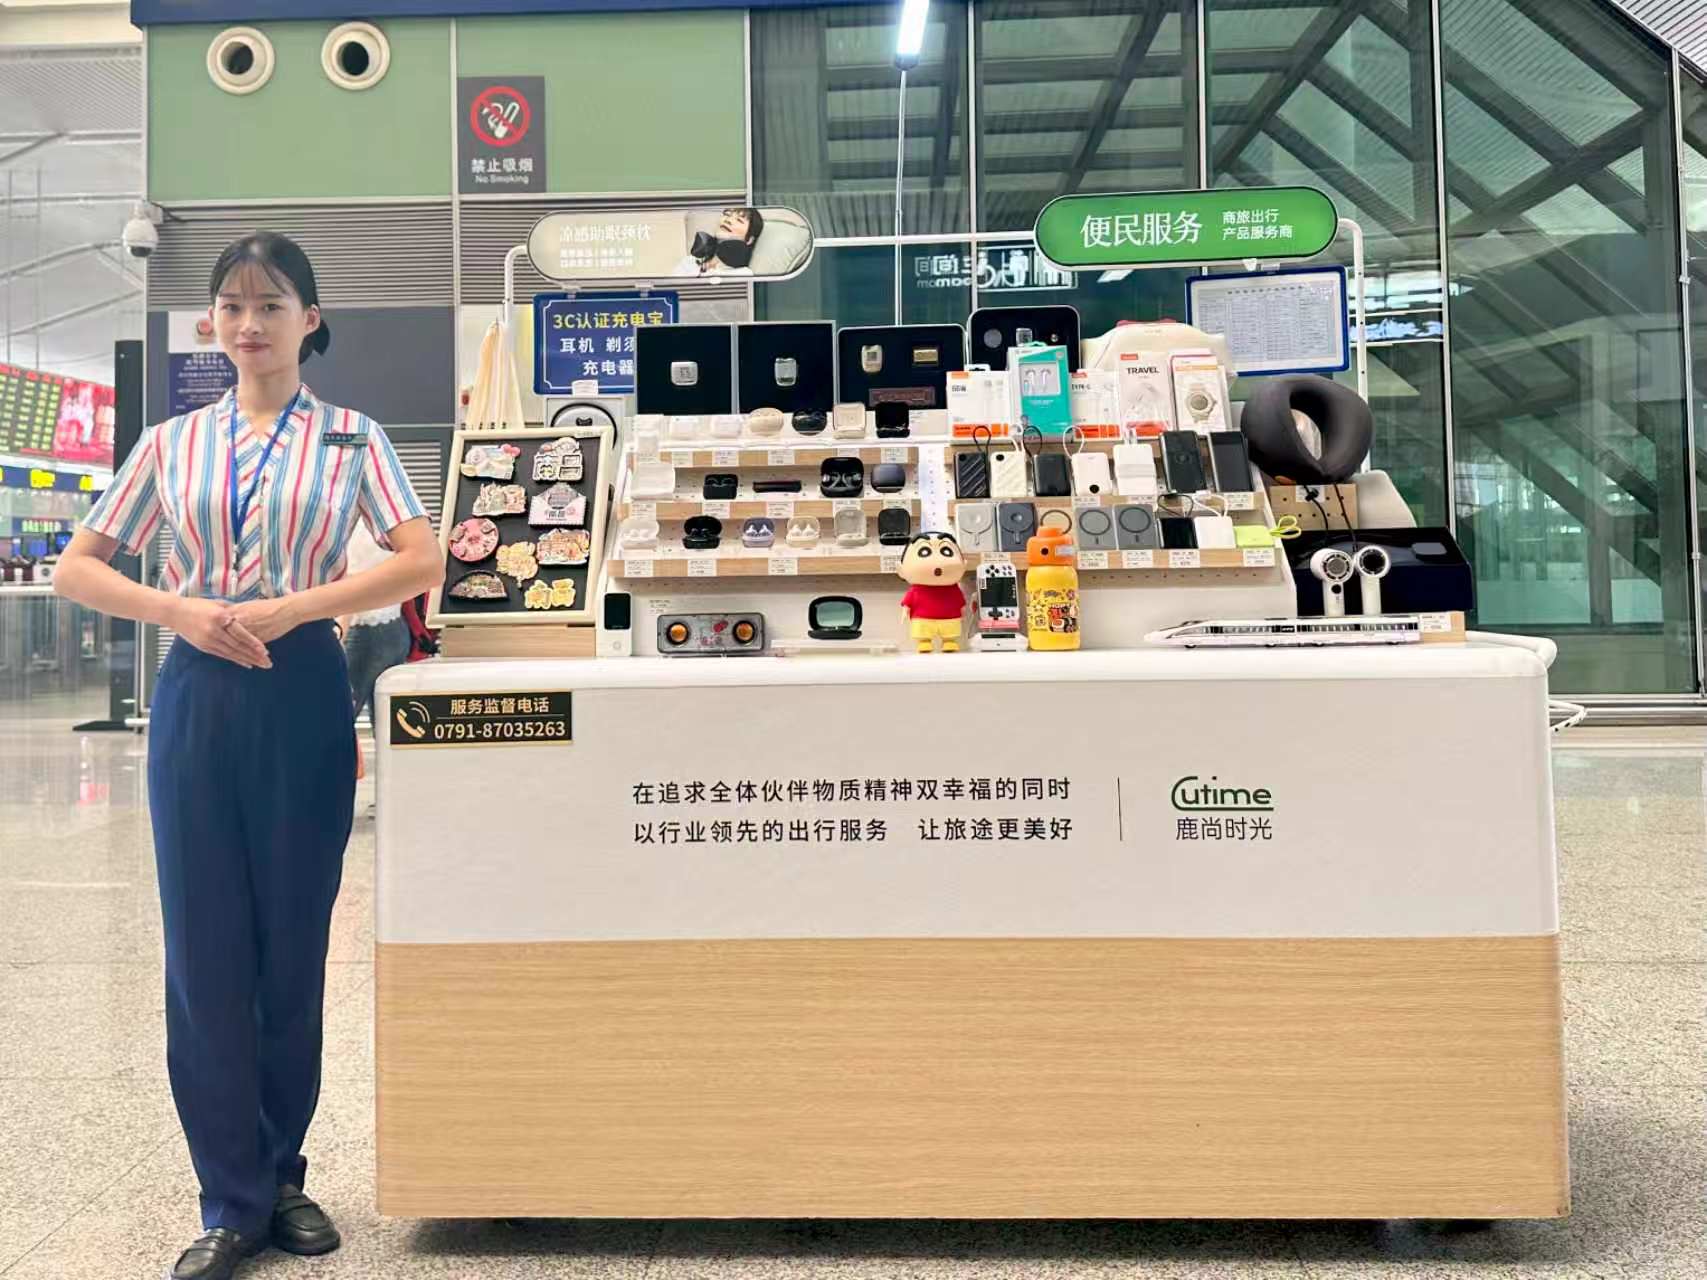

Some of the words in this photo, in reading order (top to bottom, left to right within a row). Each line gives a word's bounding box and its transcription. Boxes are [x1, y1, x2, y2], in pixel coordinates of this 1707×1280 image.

[471, 158, 533, 173] 禁止吸烟
[475, 175, 489, 184] No
[490, 174, 529, 184] Smoking
[1222, 208, 1279, 225] 商旅出行
[1080, 211, 1203, 248] 便民服务
[1222, 224, 1293, 241] 产品服务商
[553, 311, 663, 329] 3C认证充电宝
[560, 337, 594, 353] 耳机
[583, 360, 635, 376] 充电器
[1126, 366, 1160, 374] TRAVEL
[450, 697, 550, 715] 服务监督电话
[434, 721, 566, 739] 0791-87035263
[632, 777, 1071, 805] 在追求全体伙伴物质精神双幸福的同时
[1172, 776, 1274, 811] Cutime
[634, 818, 889, 844] 以行业领先的出行服务
[918, 816, 1073, 842] 让旅途更美好
[1175, 816, 1273, 841] 鹿尚时光
